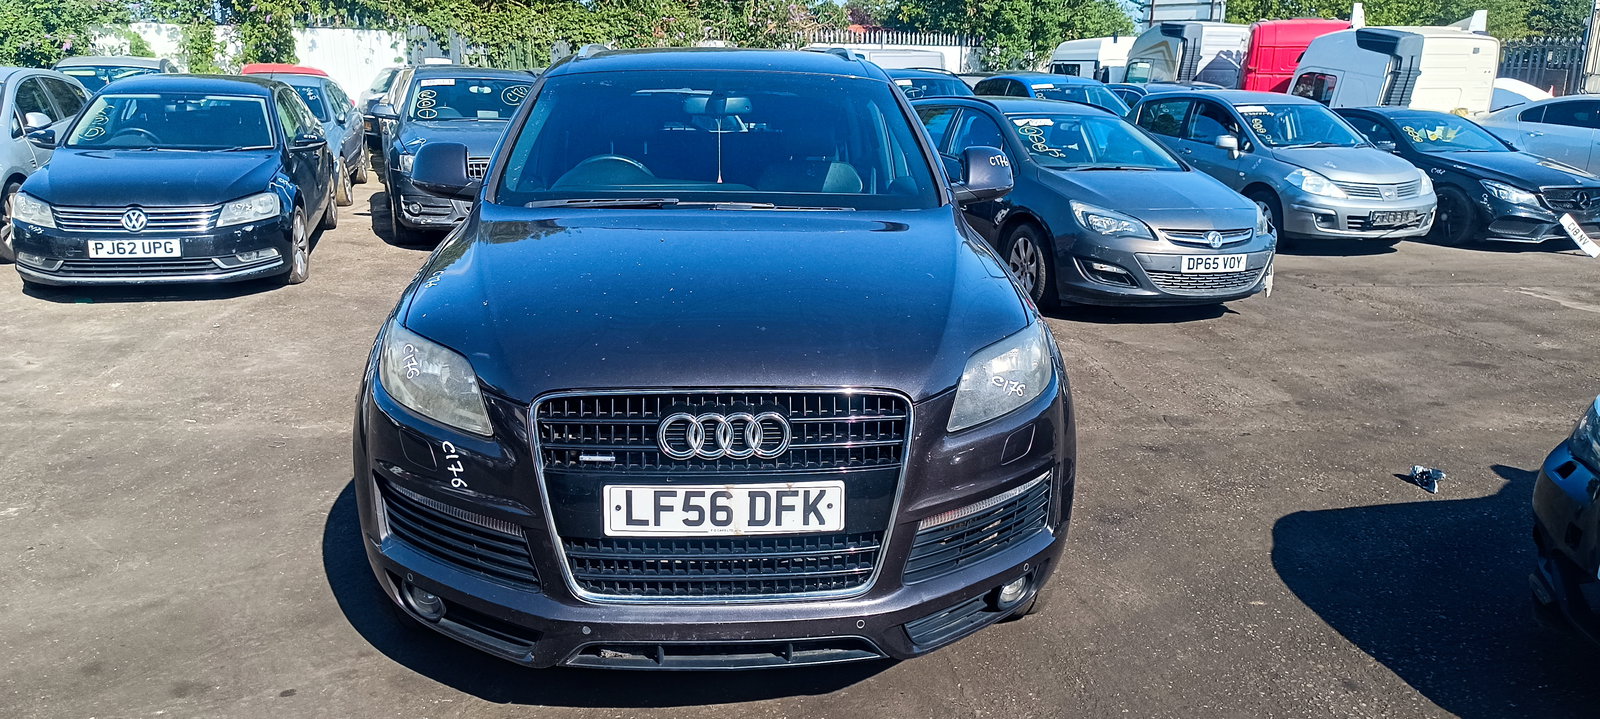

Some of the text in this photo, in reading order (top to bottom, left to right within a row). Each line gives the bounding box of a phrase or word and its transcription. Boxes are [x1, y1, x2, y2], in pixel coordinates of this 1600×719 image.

[94, 241, 174, 255] PJ62 UPG
[1187, 256, 1243, 271] DP65 VOY
[402, 343, 420, 379] C176
[991, 375, 1026, 397] C176
[442, 440, 468, 488] C176
[625, 489, 827, 527] LF56 DFK
